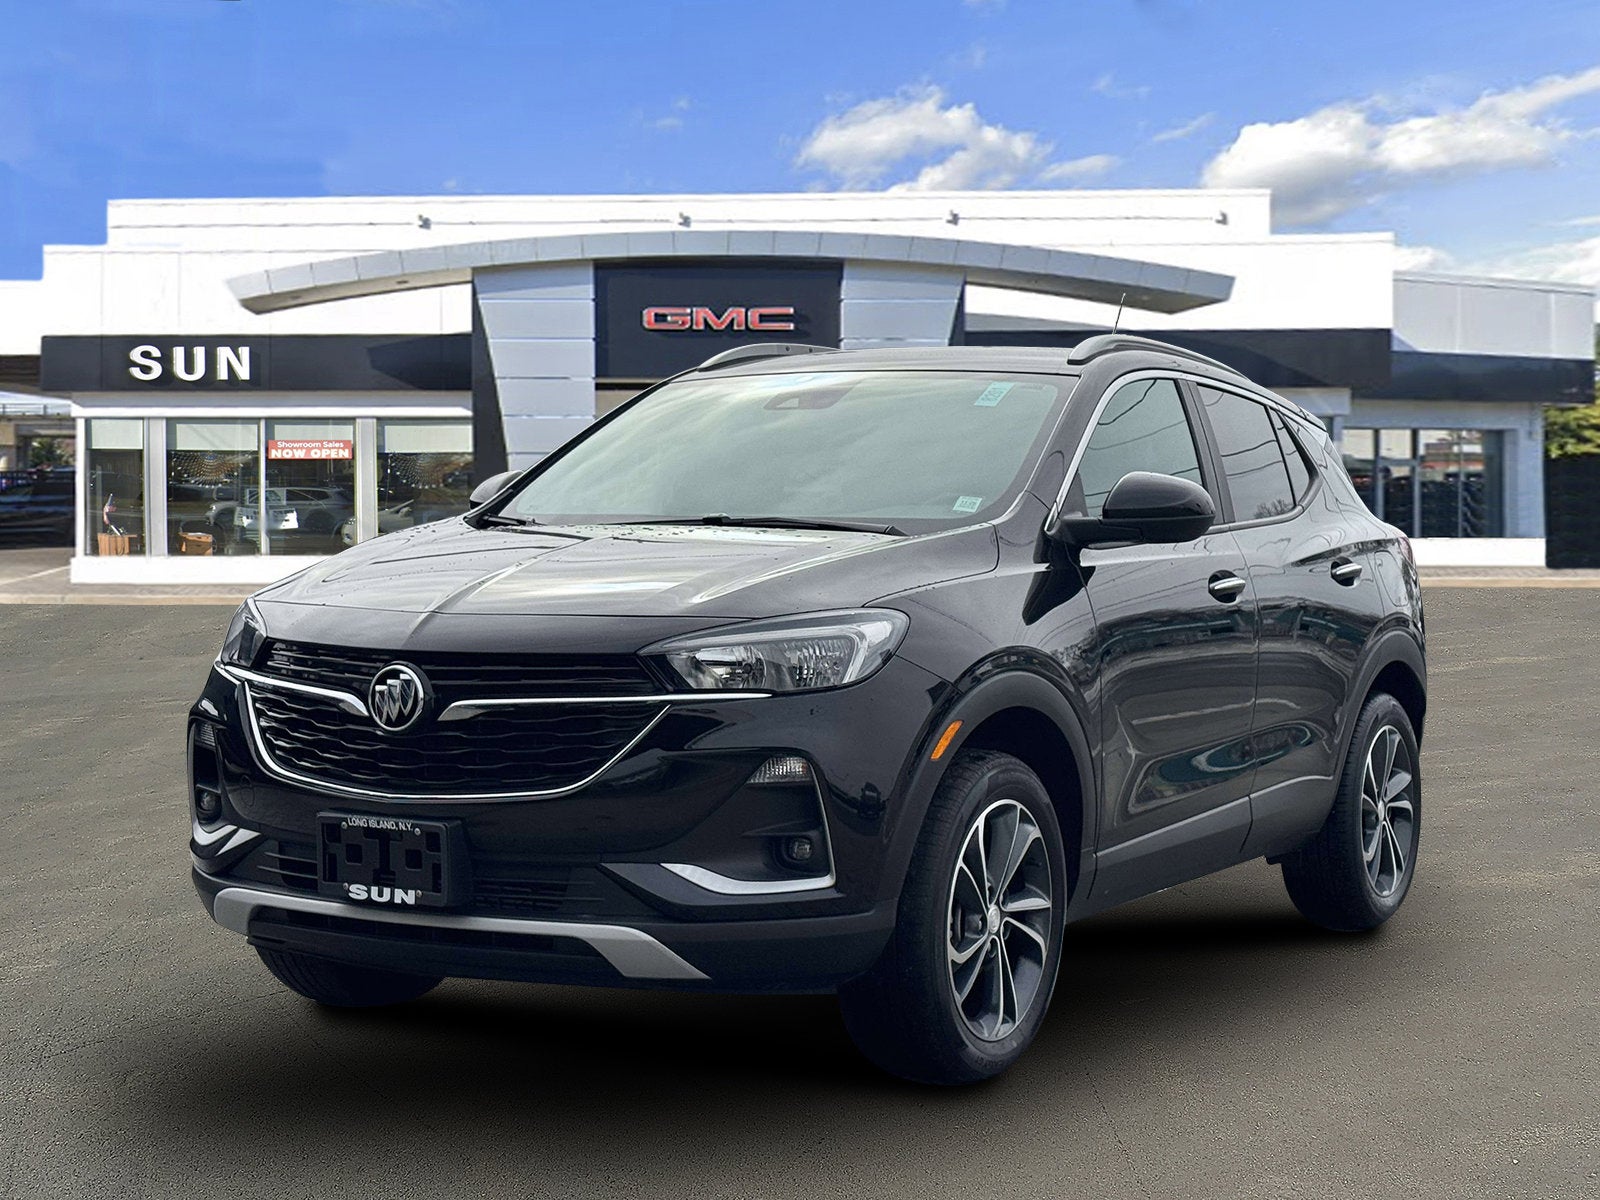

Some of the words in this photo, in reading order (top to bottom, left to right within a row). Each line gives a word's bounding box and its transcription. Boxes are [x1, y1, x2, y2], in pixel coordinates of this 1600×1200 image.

[642, 306, 795, 330] GMC
[128, 344, 252, 382] SUN
[271, 449, 306, 458] NOW
[310, 449, 349, 458] OPEN
[347, 816, 368, 828] LONG
[368, 818, 399, 831] ISLAND,
[347, 883, 417, 905] SUN
